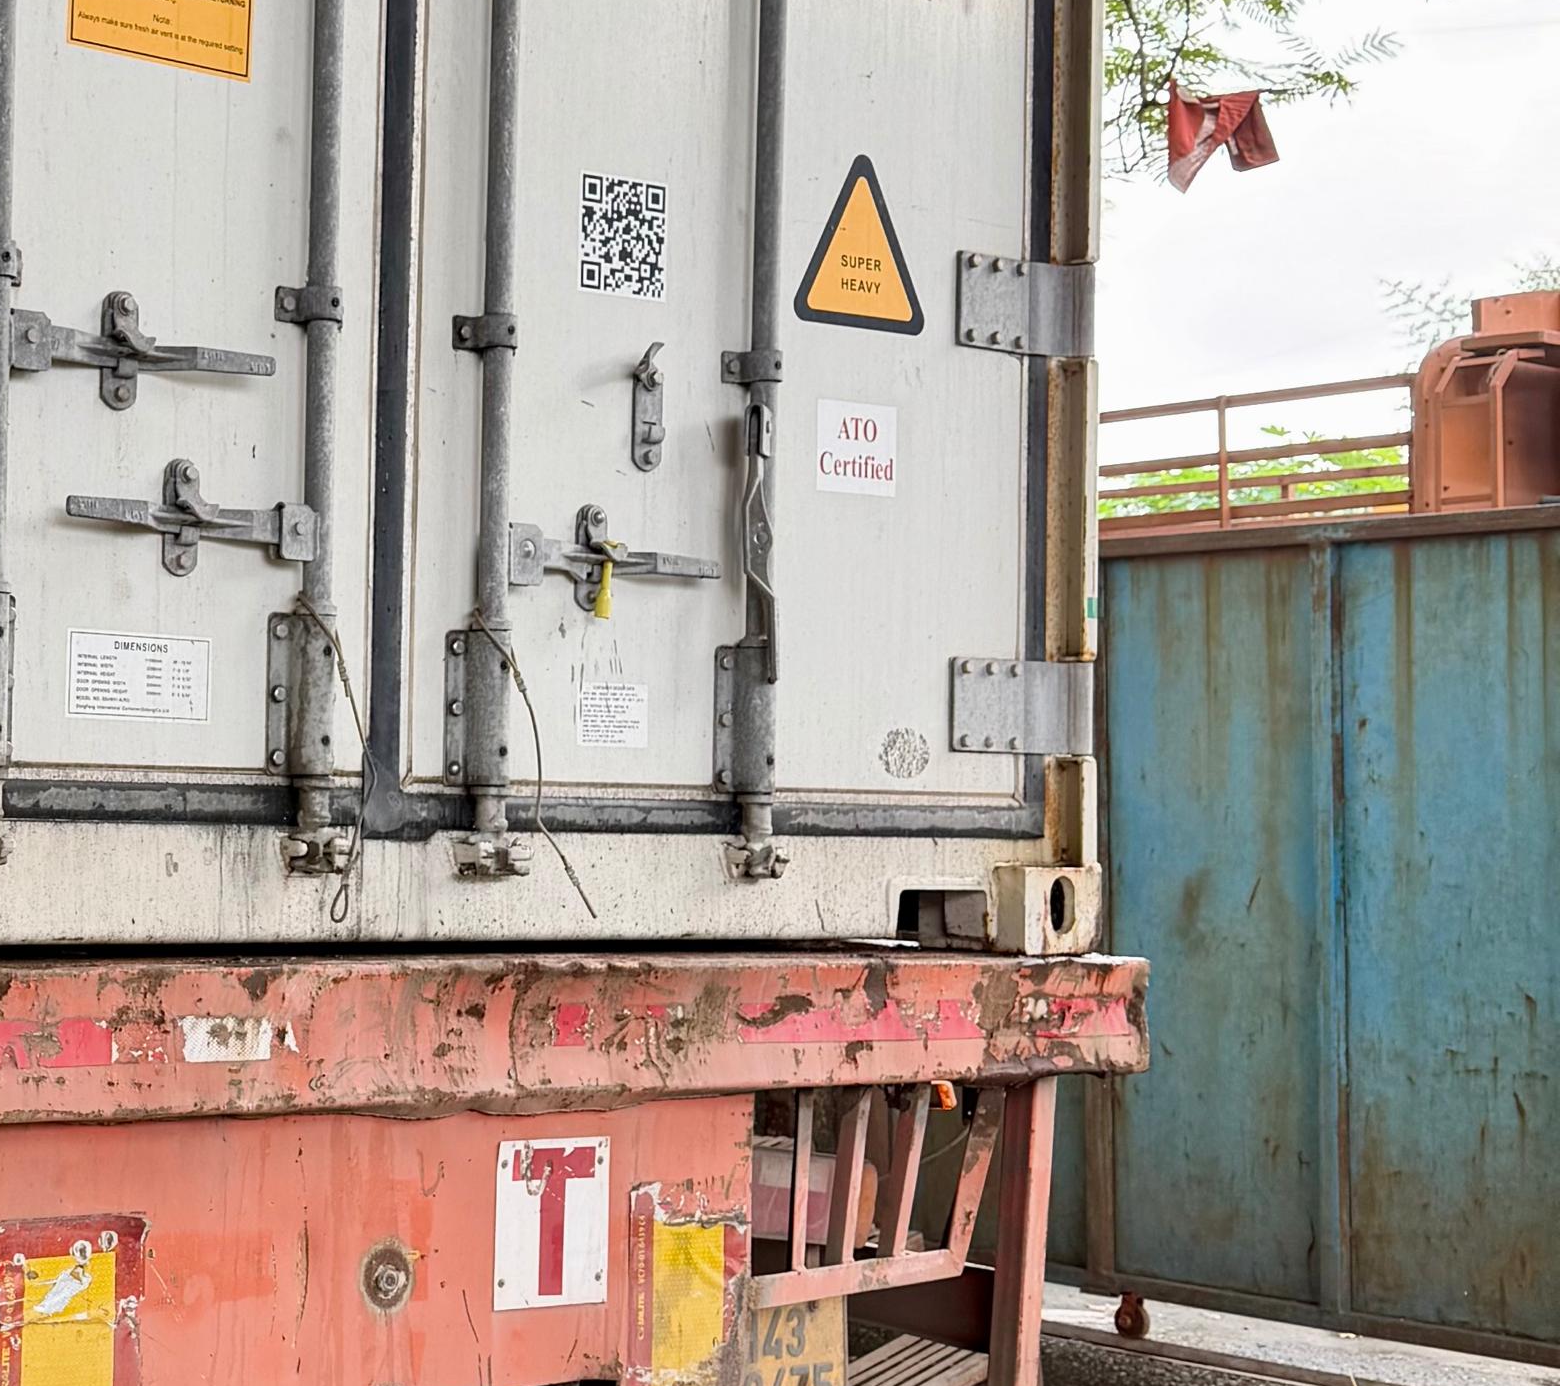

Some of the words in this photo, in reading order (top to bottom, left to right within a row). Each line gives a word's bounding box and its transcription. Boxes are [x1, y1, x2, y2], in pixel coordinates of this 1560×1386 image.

[840, 253, 882, 273] SUPER
[840, 276, 882, 296] HEAVY
[837, 416, 879, 444] ATO
[819, 451, 895, 483] Certified
[114, 640, 168, 653] DIMENSIONS
[512, 1146, 596, 1296] T
